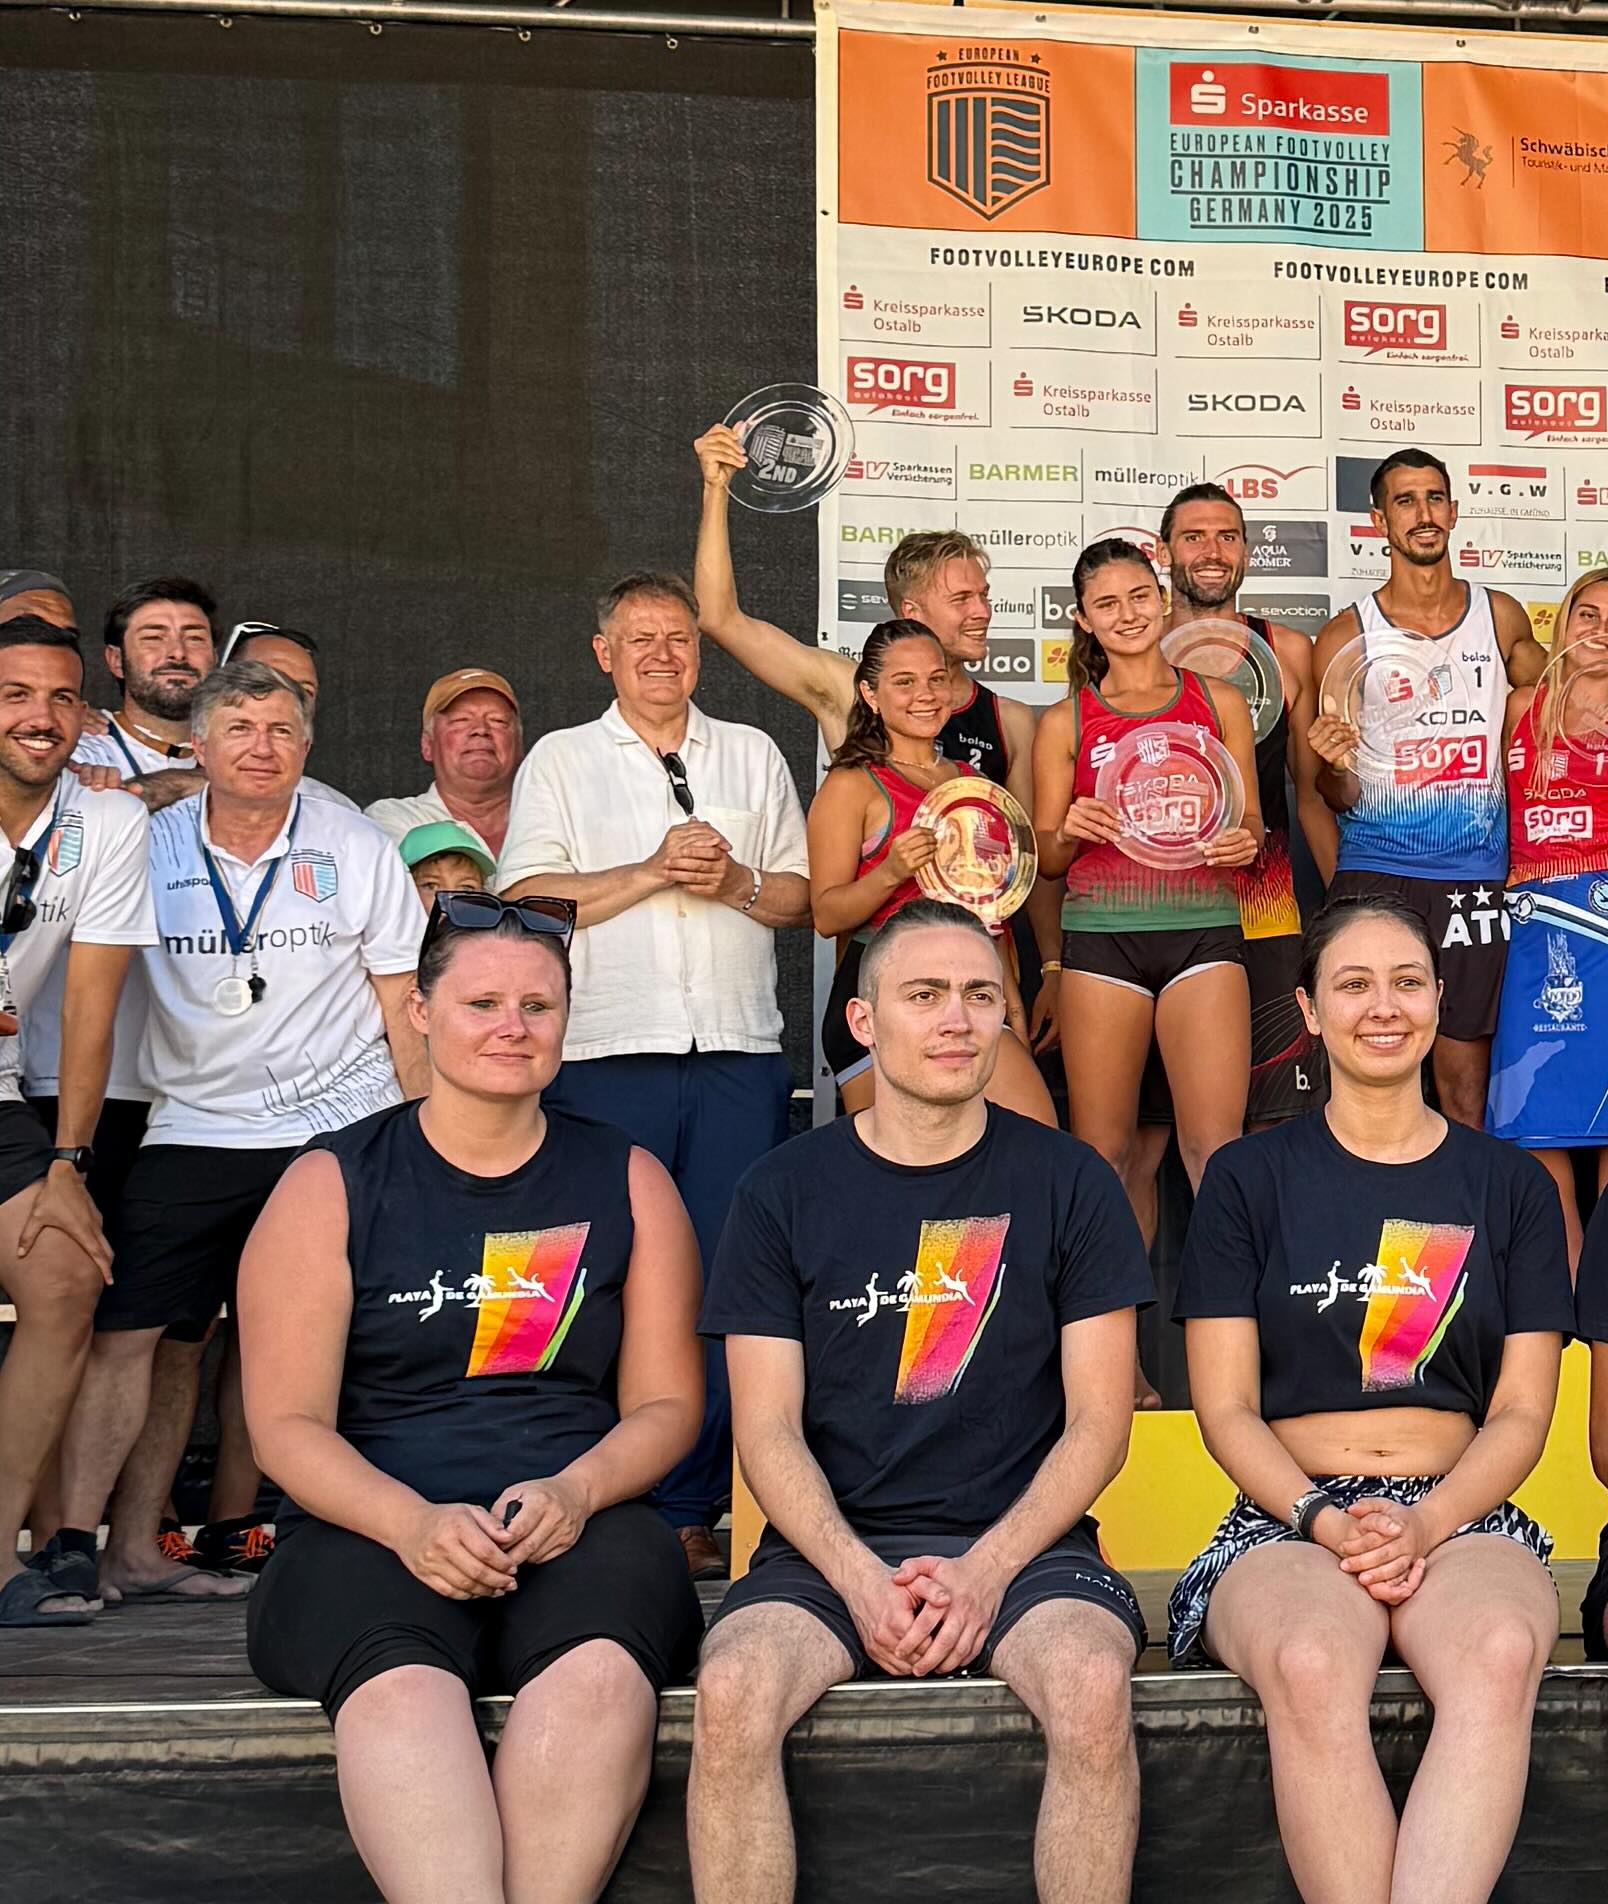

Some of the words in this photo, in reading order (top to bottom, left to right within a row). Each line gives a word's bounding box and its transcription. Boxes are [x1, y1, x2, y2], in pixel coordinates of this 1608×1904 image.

[959, 48, 1019, 62] EUROPEAN
[927, 72, 1001, 89] FOOTVOLLEY
[1006, 73, 1050, 93] LEAGUE
[1241, 93, 1369, 124] Sparkasse
[1171, 133, 1266, 154] EUROPEAN
[1277, 136, 1390, 162] FOOTVOLLEY
[1570, 163, 1590, 173] und
[1171, 159, 1390, 198] CHAMPIONSHIP
[1190, 198, 1300, 225] GERMANY
[1314, 203, 1372, 230] 2025
[874, 299, 985, 319] Kreissparkasse
[874, 317, 921, 333] Ostalb
[1207, 314, 1315, 331] Kreissparkasse
[1350, 307, 1440, 344] sorg
[1207, 333, 1253, 347] Ostalb
[1529, 346, 1574, 359] Ostalb
[854, 362, 948, 403] sorg
[1043, 385, 1151, 403] Kreissparkasse
[1043, 403, 1089, 418] Ostalb
[1370, 400, 1475, 416] Kreissparkasse
[1511, 390, 1600, 426] sorg
[1370, 417, 1415, 431] Ostalb
[759, 460, 797, 483] 2ND
[893, 462, 952, 473] Sparkassen
[969, 463, 1078, 482] BARMER
[888, 472, 952, 485] Versicherung
[1095, 467, 1199, 488] mülleroptik
[1227, 478, 1278, 498] LBS
[1252, 546, 1287, 556] AQUA
[1507, 550, 1561, 560] Sparkassen
[1502, 560, 1561, 571] Versicherung
[1261, 608, 1327, 616] sevotion
[1474, 666, 1482, 688] 1
[959, 733, 993, 750] bolao
[969, 748, 981, 770] 2
[1596, 752, 1605, 776] 1
[1528, 808, 1587, 833] sorg
[388, 1290, 432, 1304] PLAYA
[446, 1291, 464, 1300] DE
[1290, 1283, 1328, 1295] PLAYA
[1340, 1284, 1357, 1293] DE
[829, 1297, 868, 1311] PLAYA
[880, 1293, 897, 1305] DE
